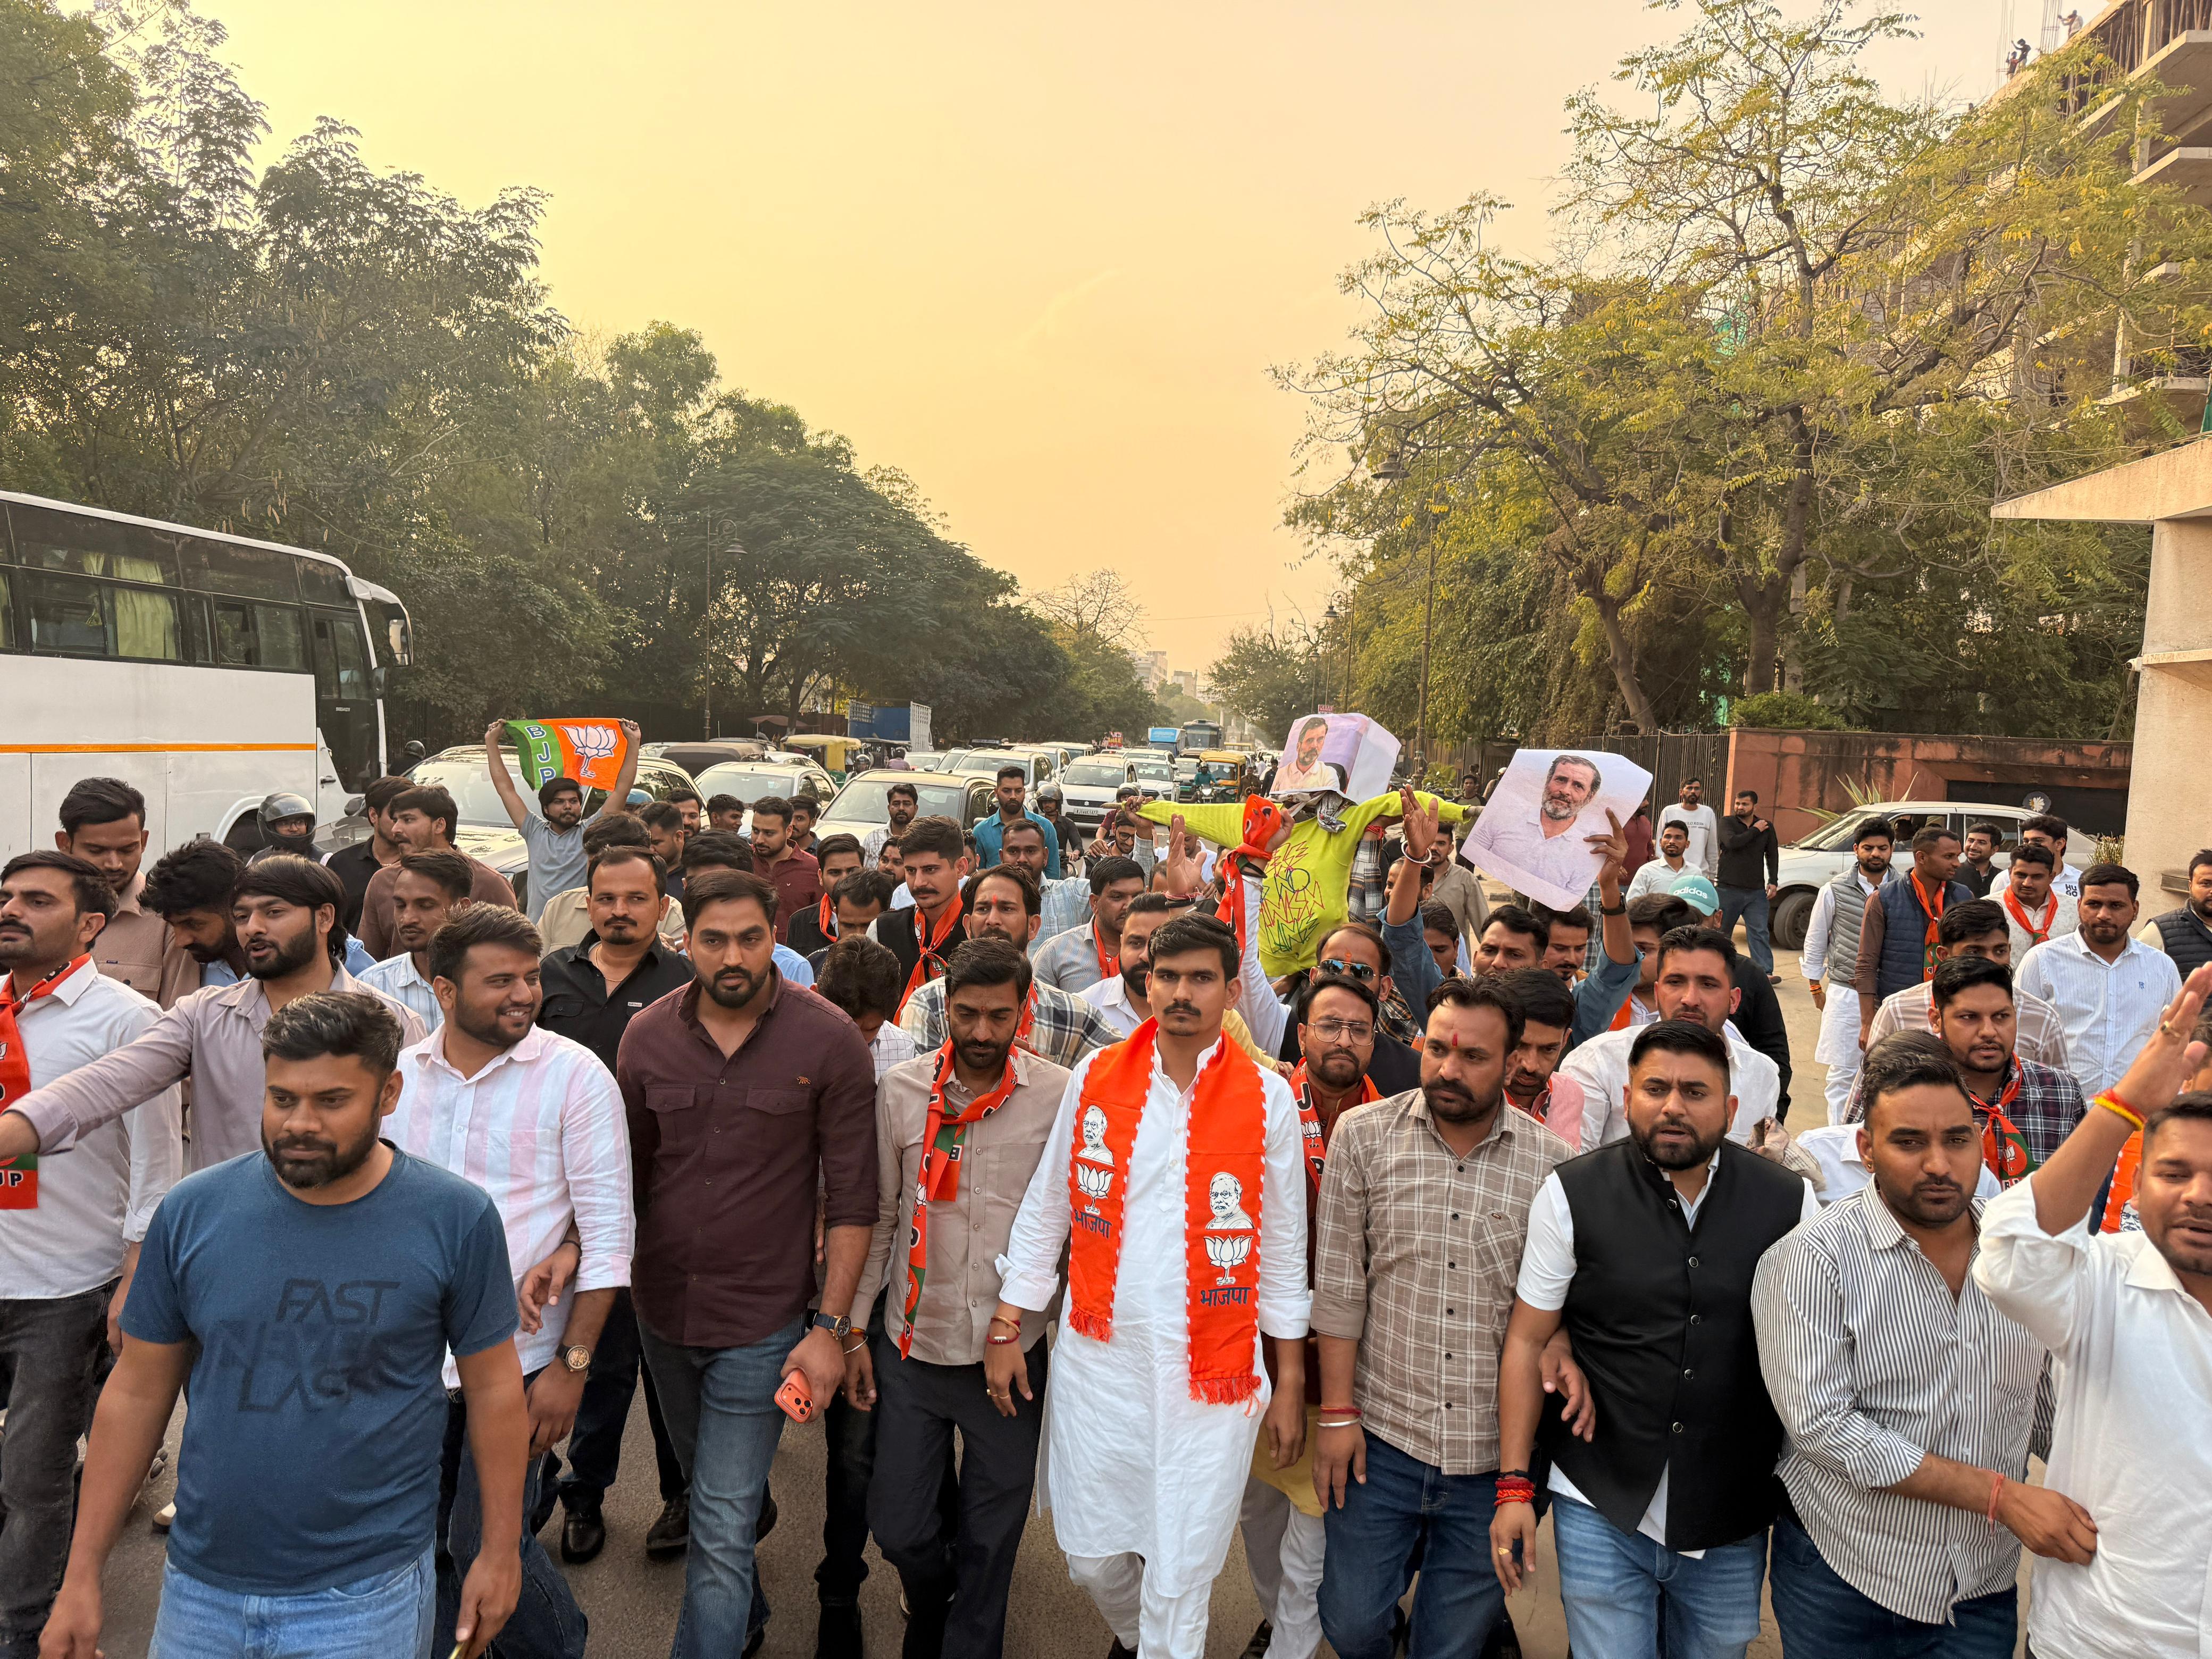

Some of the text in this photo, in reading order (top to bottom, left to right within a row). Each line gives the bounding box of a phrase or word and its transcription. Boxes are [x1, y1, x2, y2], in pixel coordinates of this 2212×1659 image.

[525, 725, 556, 787] BJP
[1673, 886, 1707, 899] adidas
[1074, 1208, 1112, 1239] भाजपा
[275, 1278, 400, 1325] FAST
[1201, 1287, 1252, 1307] भाजपा
